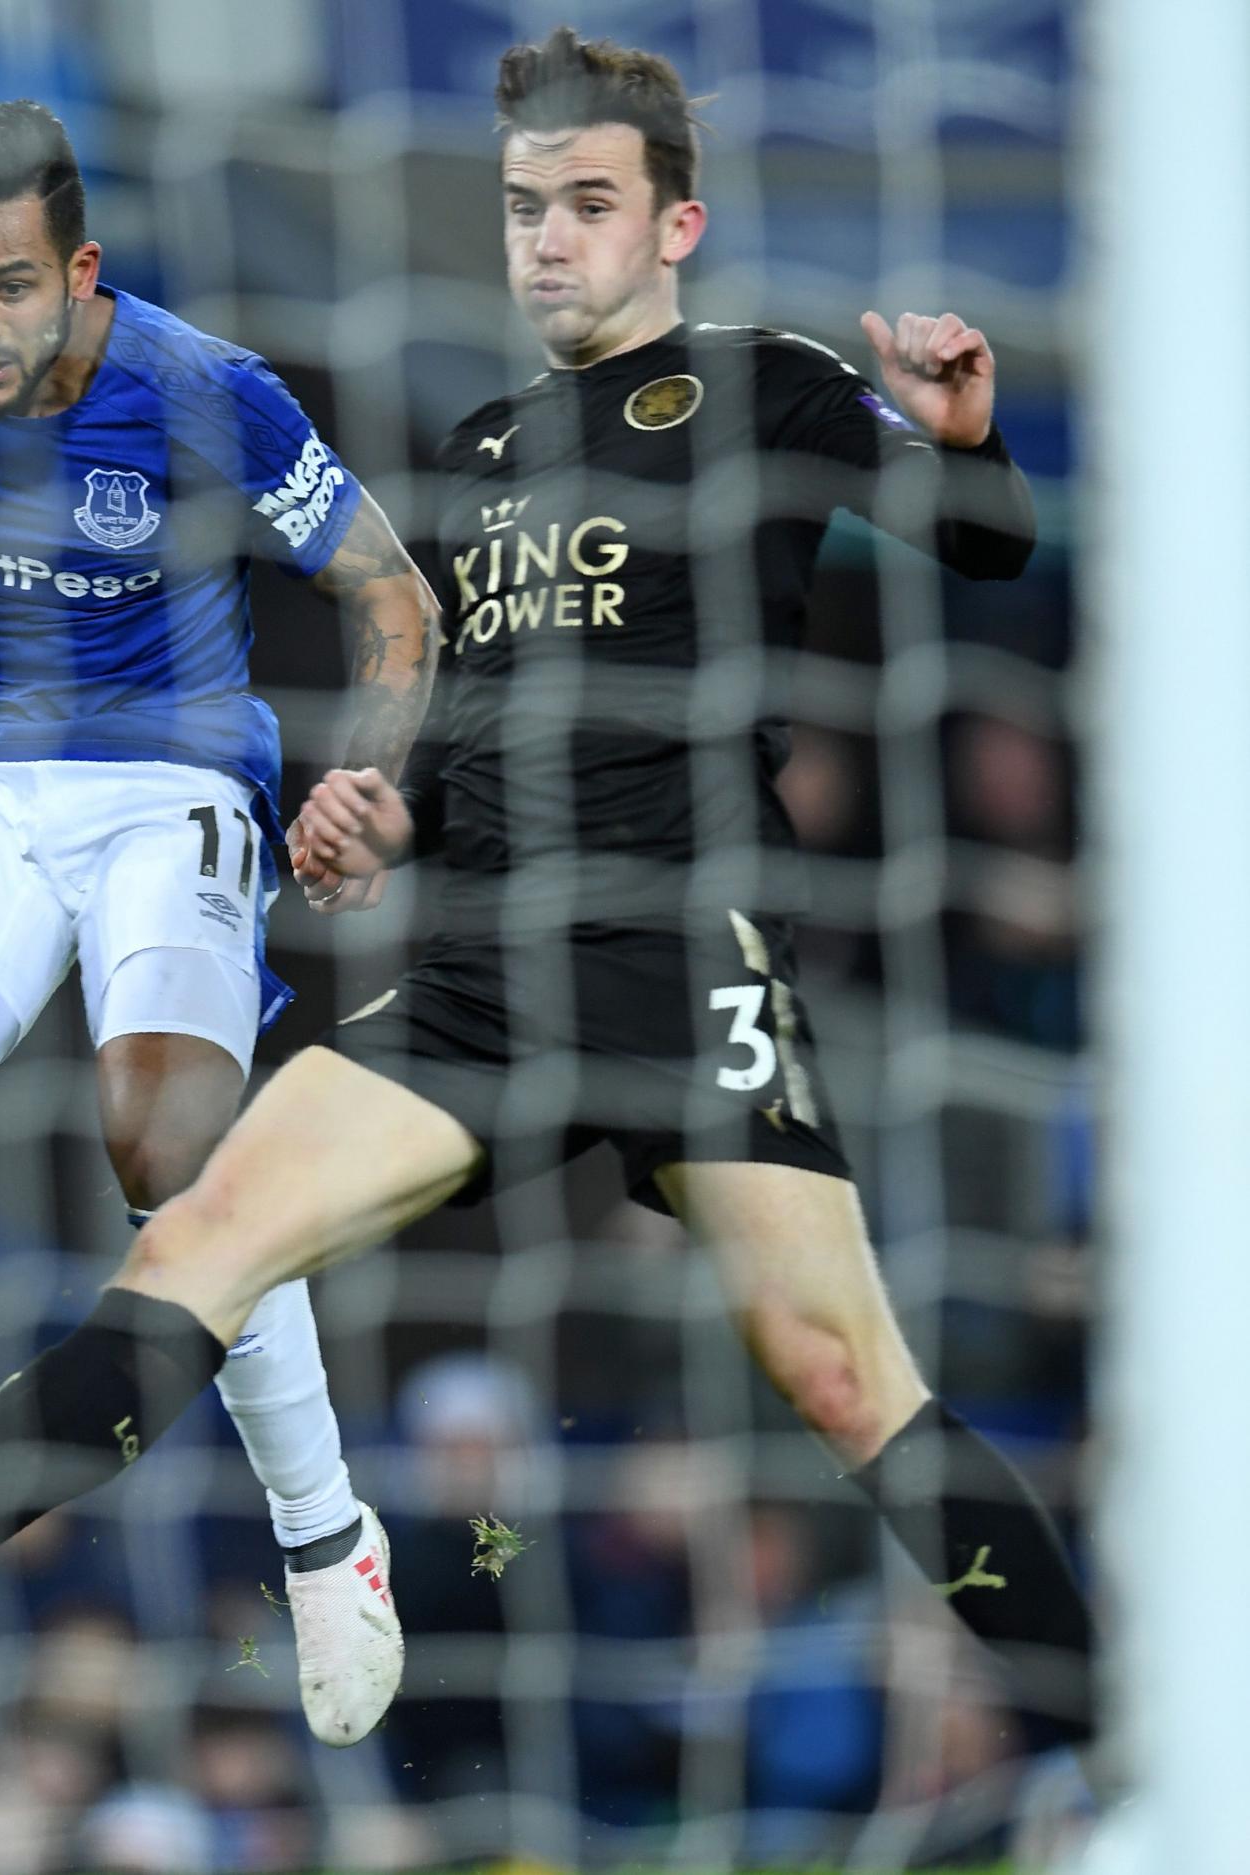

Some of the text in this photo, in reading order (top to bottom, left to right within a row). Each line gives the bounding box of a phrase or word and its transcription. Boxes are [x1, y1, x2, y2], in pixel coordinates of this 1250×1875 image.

[251, 427, 329, 519] ANGR
[453, 515, 629, 613] KING
[187, 805, 254, 899] 11
[708, 983, 778, 1092] 3
